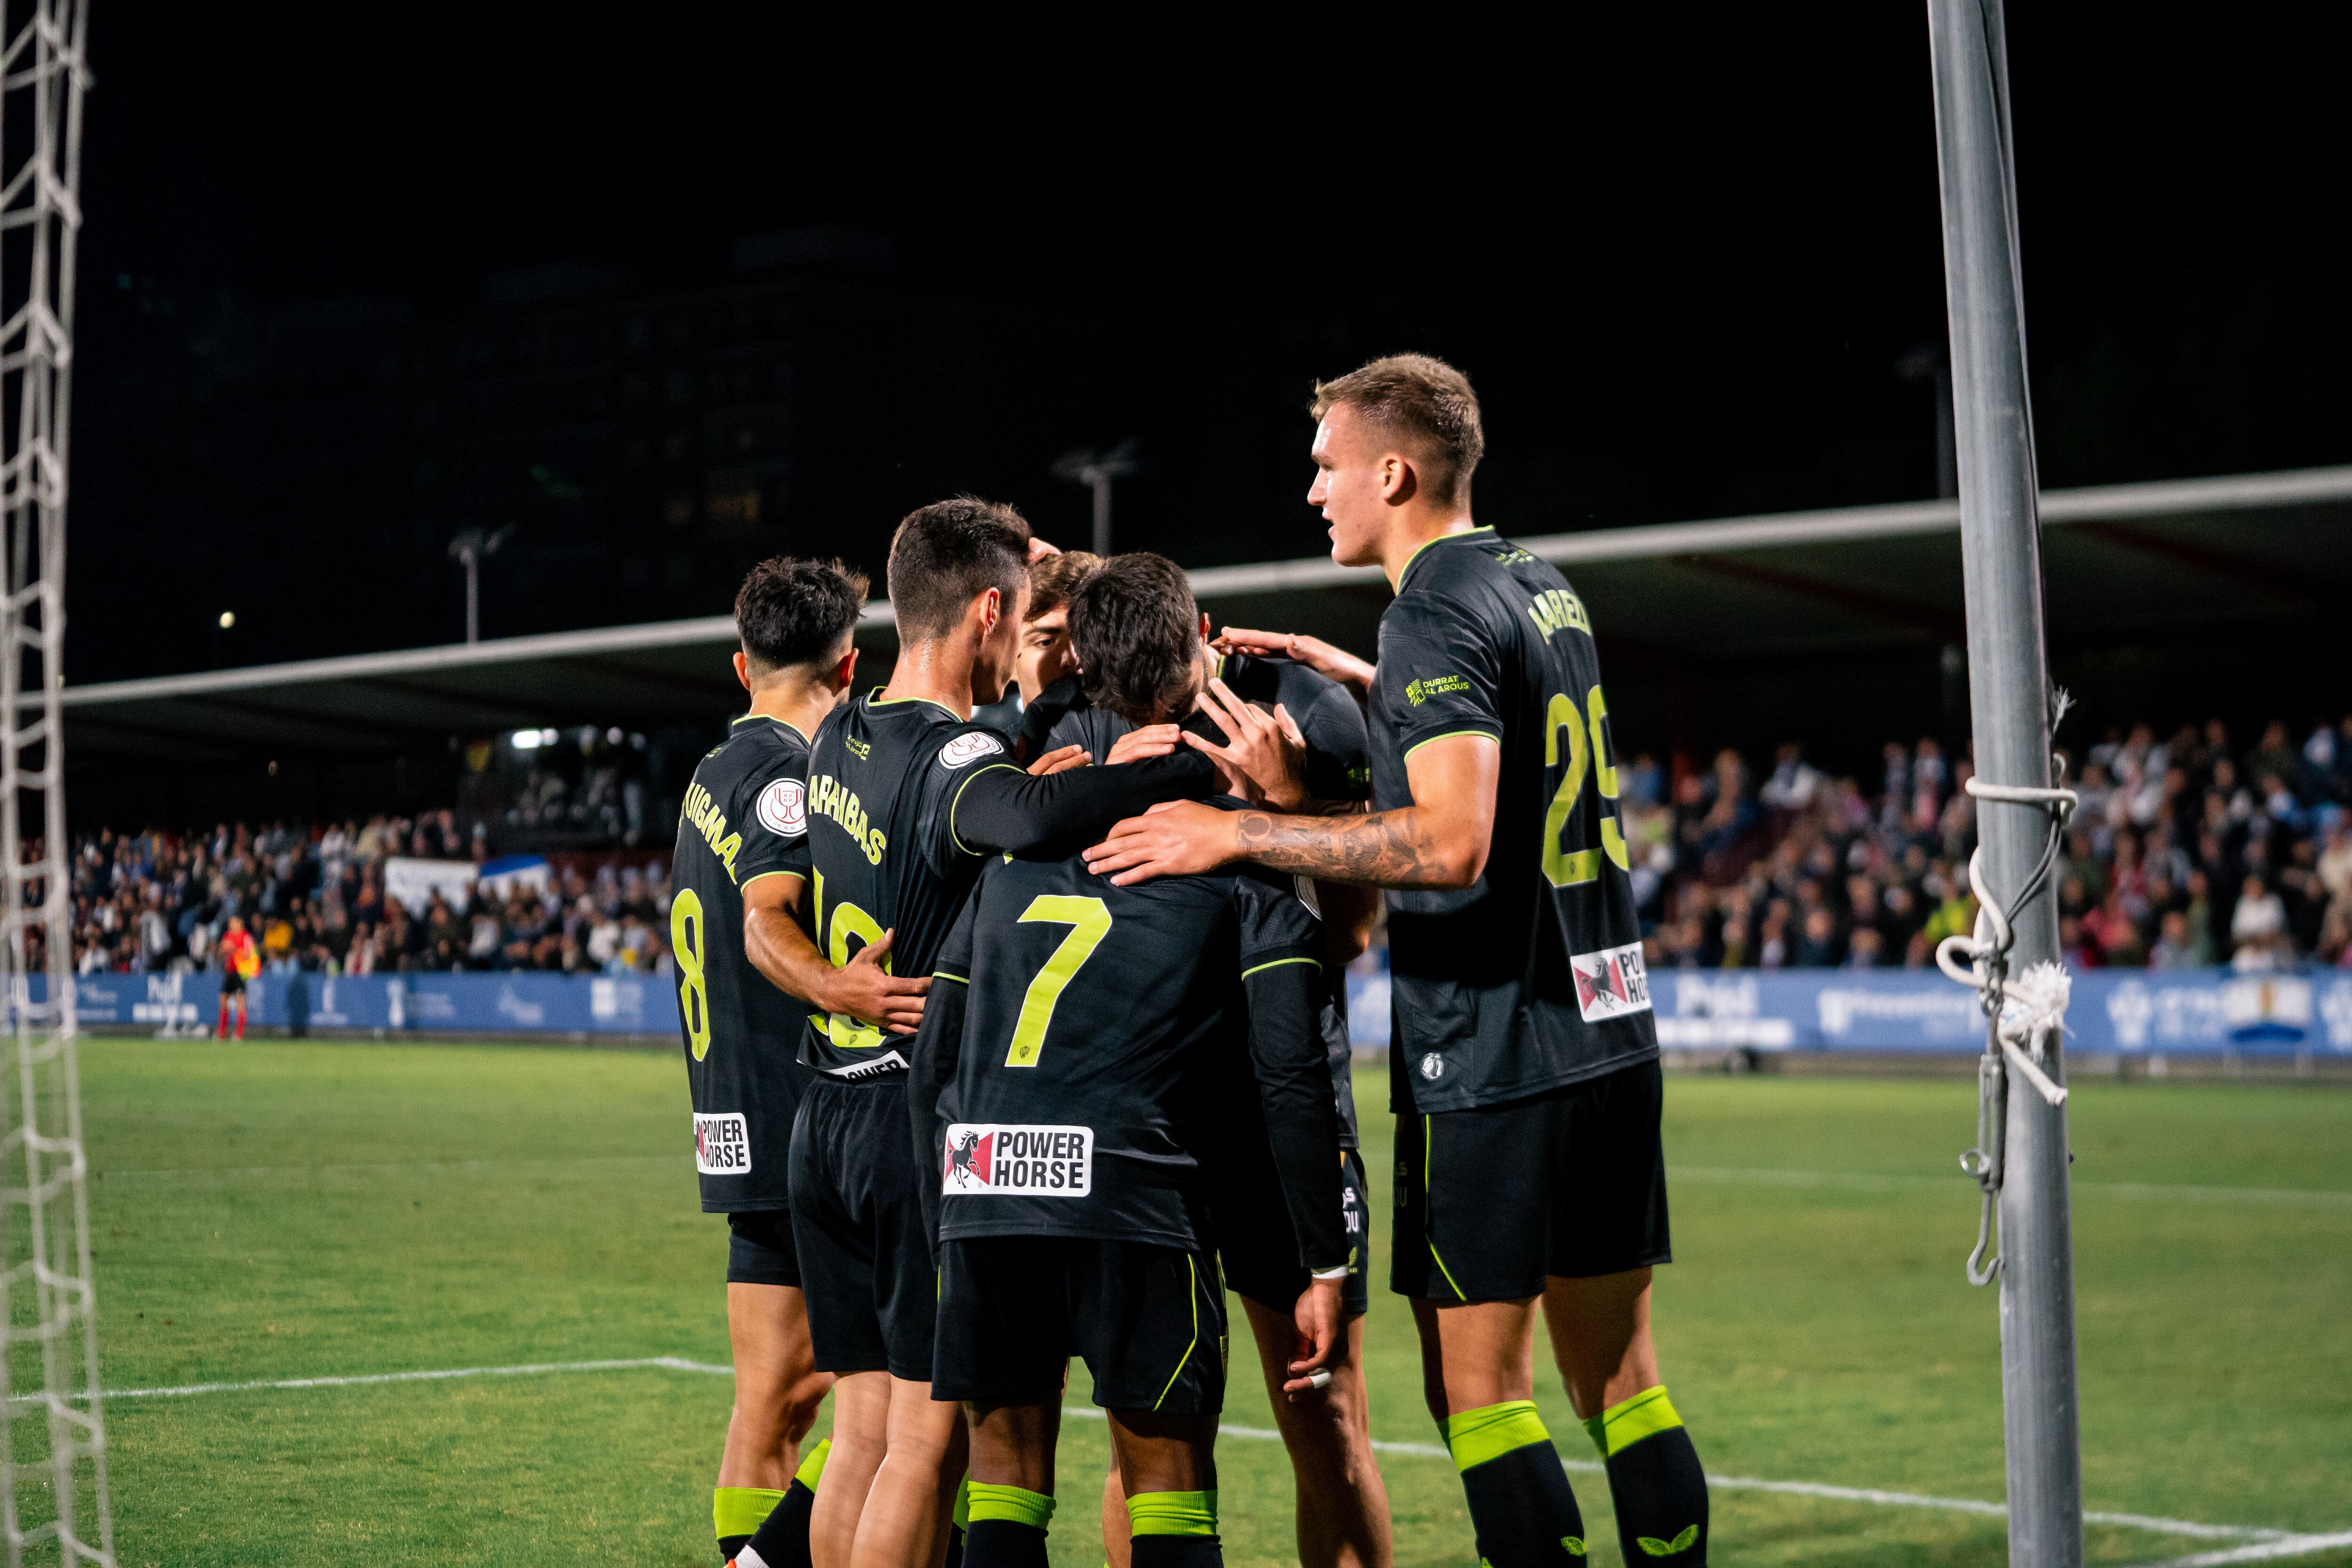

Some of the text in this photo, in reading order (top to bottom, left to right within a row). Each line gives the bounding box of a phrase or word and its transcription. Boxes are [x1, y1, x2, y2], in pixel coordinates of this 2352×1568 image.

[1423, 675, 1458, 688] DURRAT
[1438, 682, 1469, 693] AROUS
[670, 888, 710, 1061] 8
[1016, 894, 1112, 1067] 7
[703, 1119, 743, 1143] POWER
[705, 1144, 746, 1168] HORSE
[996, 1131, 1085, 1159] POWER
[994, 1160, 1084, 1189] HORSE
